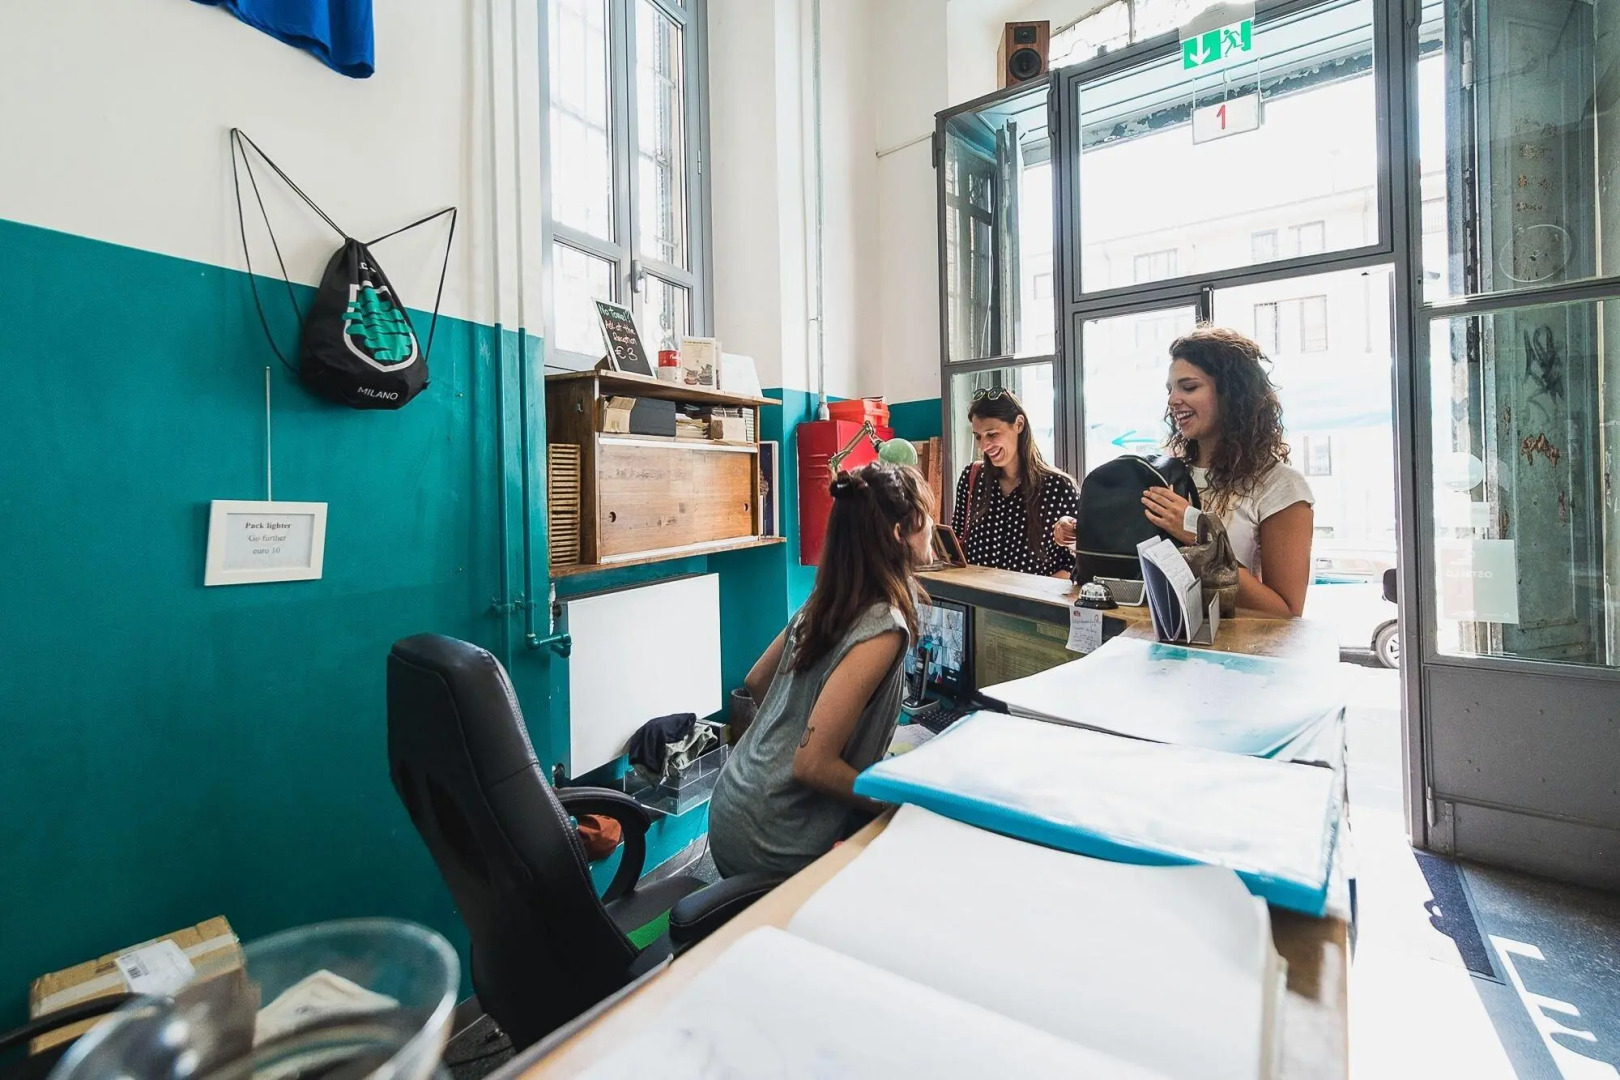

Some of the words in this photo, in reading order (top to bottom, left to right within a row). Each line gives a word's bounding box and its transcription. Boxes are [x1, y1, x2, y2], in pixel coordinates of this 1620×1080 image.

[1216, 104, 1226, 130] 1
[598, 303, 609, 316] No
[357, 386, 399, 400] MILANO
[245, 521, 264, 529] Pack
[266, 521, 292, 530] lighter
[248, 534, 261, 542] Go
[262, 534, 287, 542] further
[272, 546, 281, 554] 10
